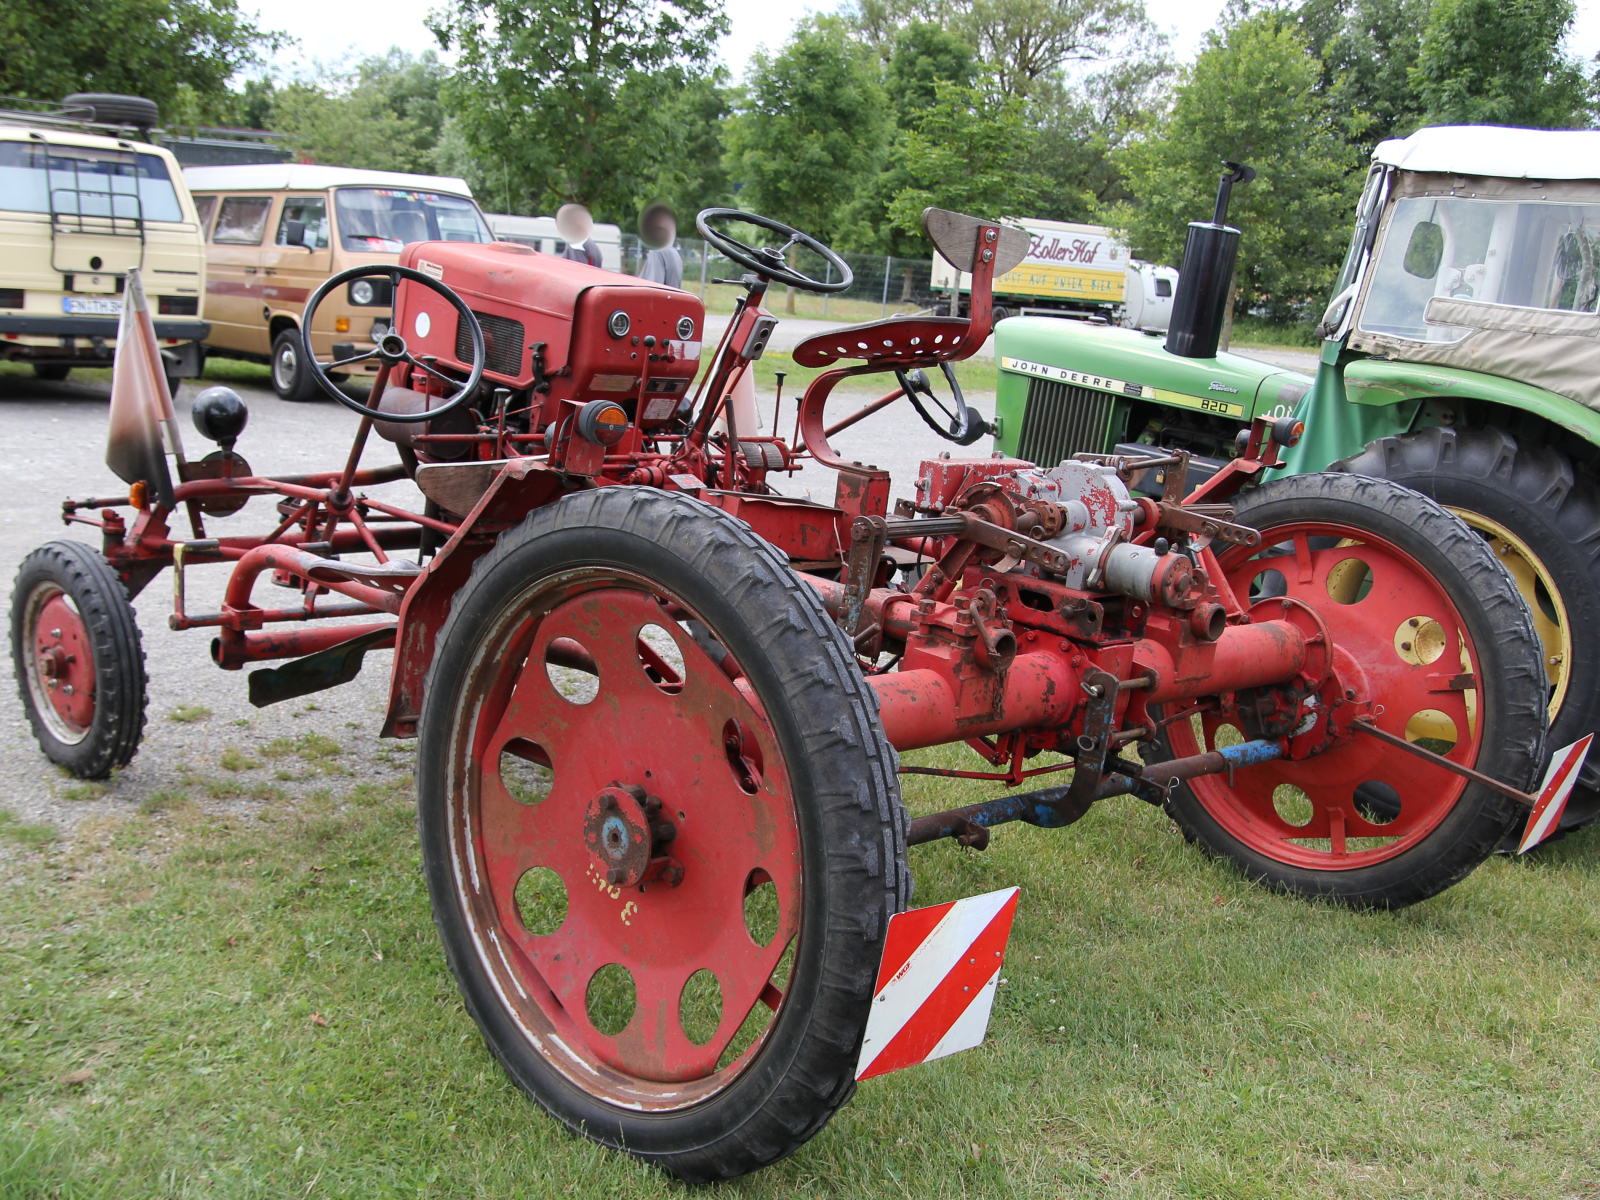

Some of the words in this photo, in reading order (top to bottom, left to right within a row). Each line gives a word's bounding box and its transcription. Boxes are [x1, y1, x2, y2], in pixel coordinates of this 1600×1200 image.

[1027, 235, 1101, 264] Zoller-Hof
[1029, 274, 1048, 287] AUF
[1053, 276, 1083, 290] UNSER
[1091, 278, 1112, 292] BIER
[1012, 360, 1049, 376] JOHN
[1060, 370, 1113, 389] DEERE
[1201, 399, 1228, 413] 820
